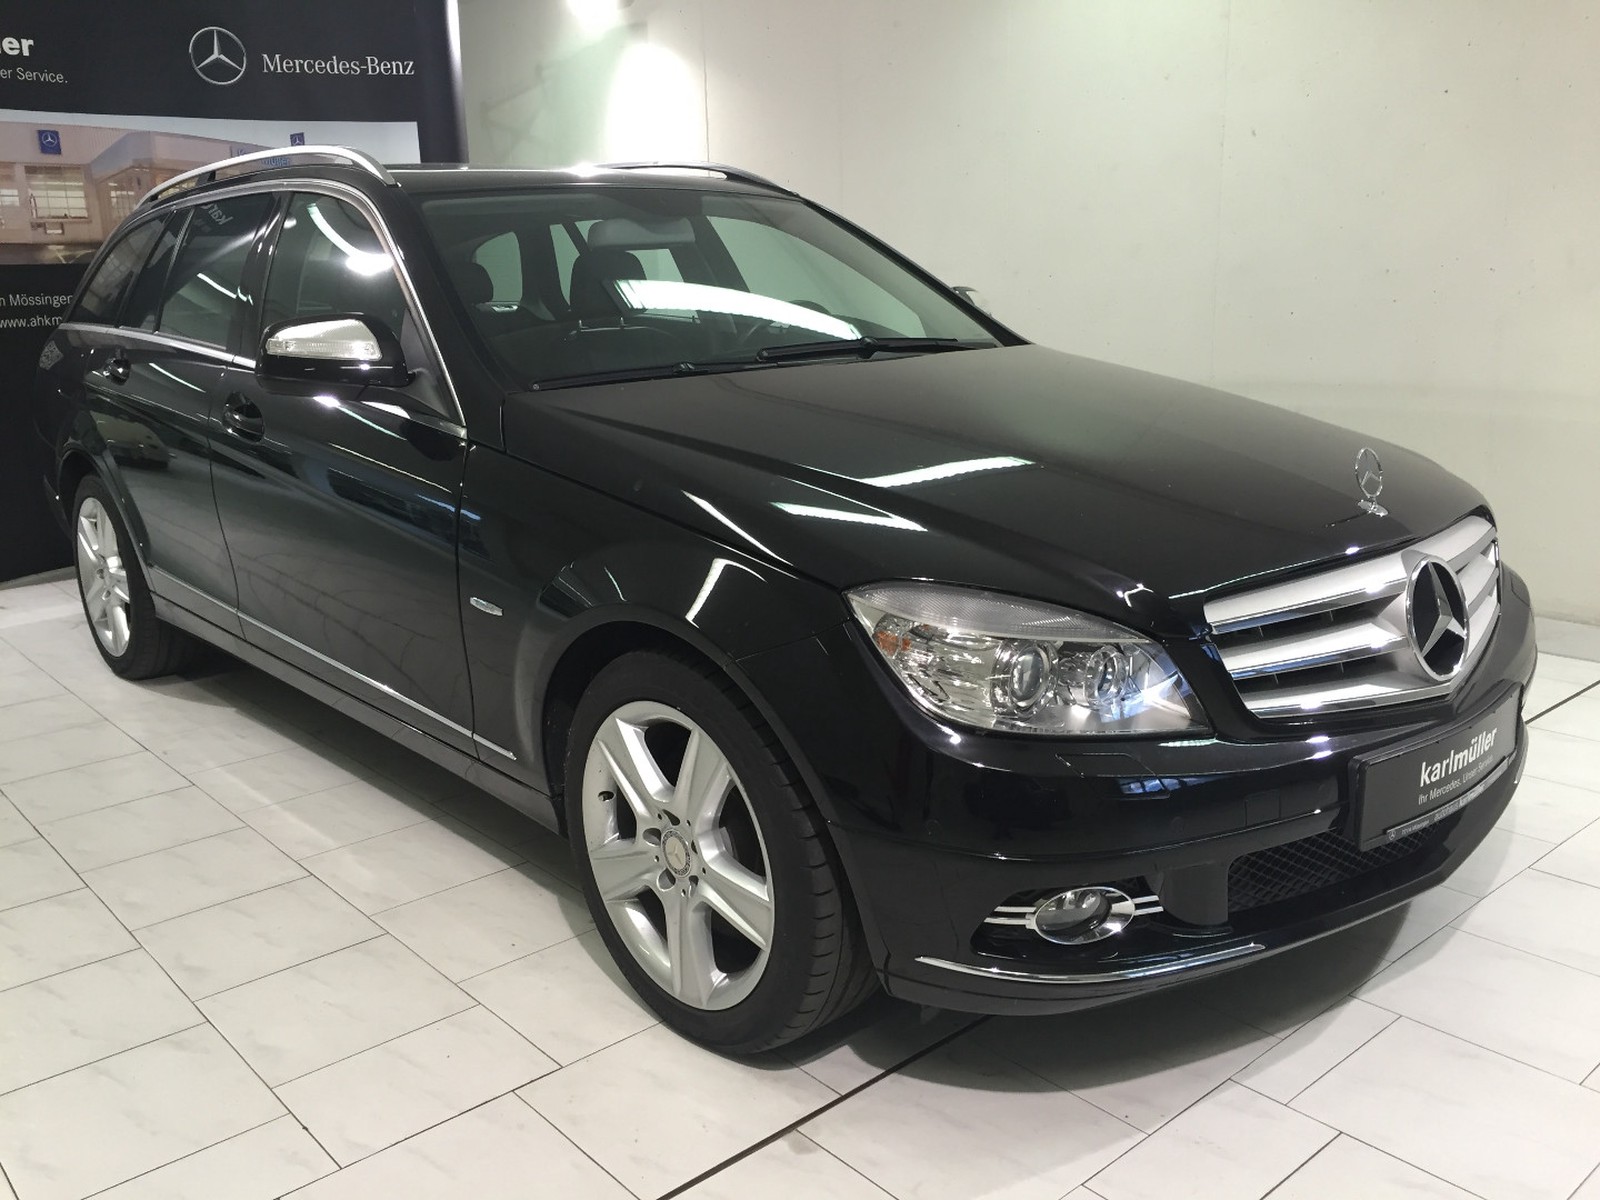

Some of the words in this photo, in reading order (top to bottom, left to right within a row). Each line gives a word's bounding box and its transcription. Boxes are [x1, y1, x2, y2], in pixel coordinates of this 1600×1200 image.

[0, 37, 34, 57] er
[262, 53, 415, 76] Mercedes-Benz
[16, 67, 68, 84] Service.
[1420, 727, 1497, 788] karlmüller
[1418, 793, 1429, 805] Ihr
